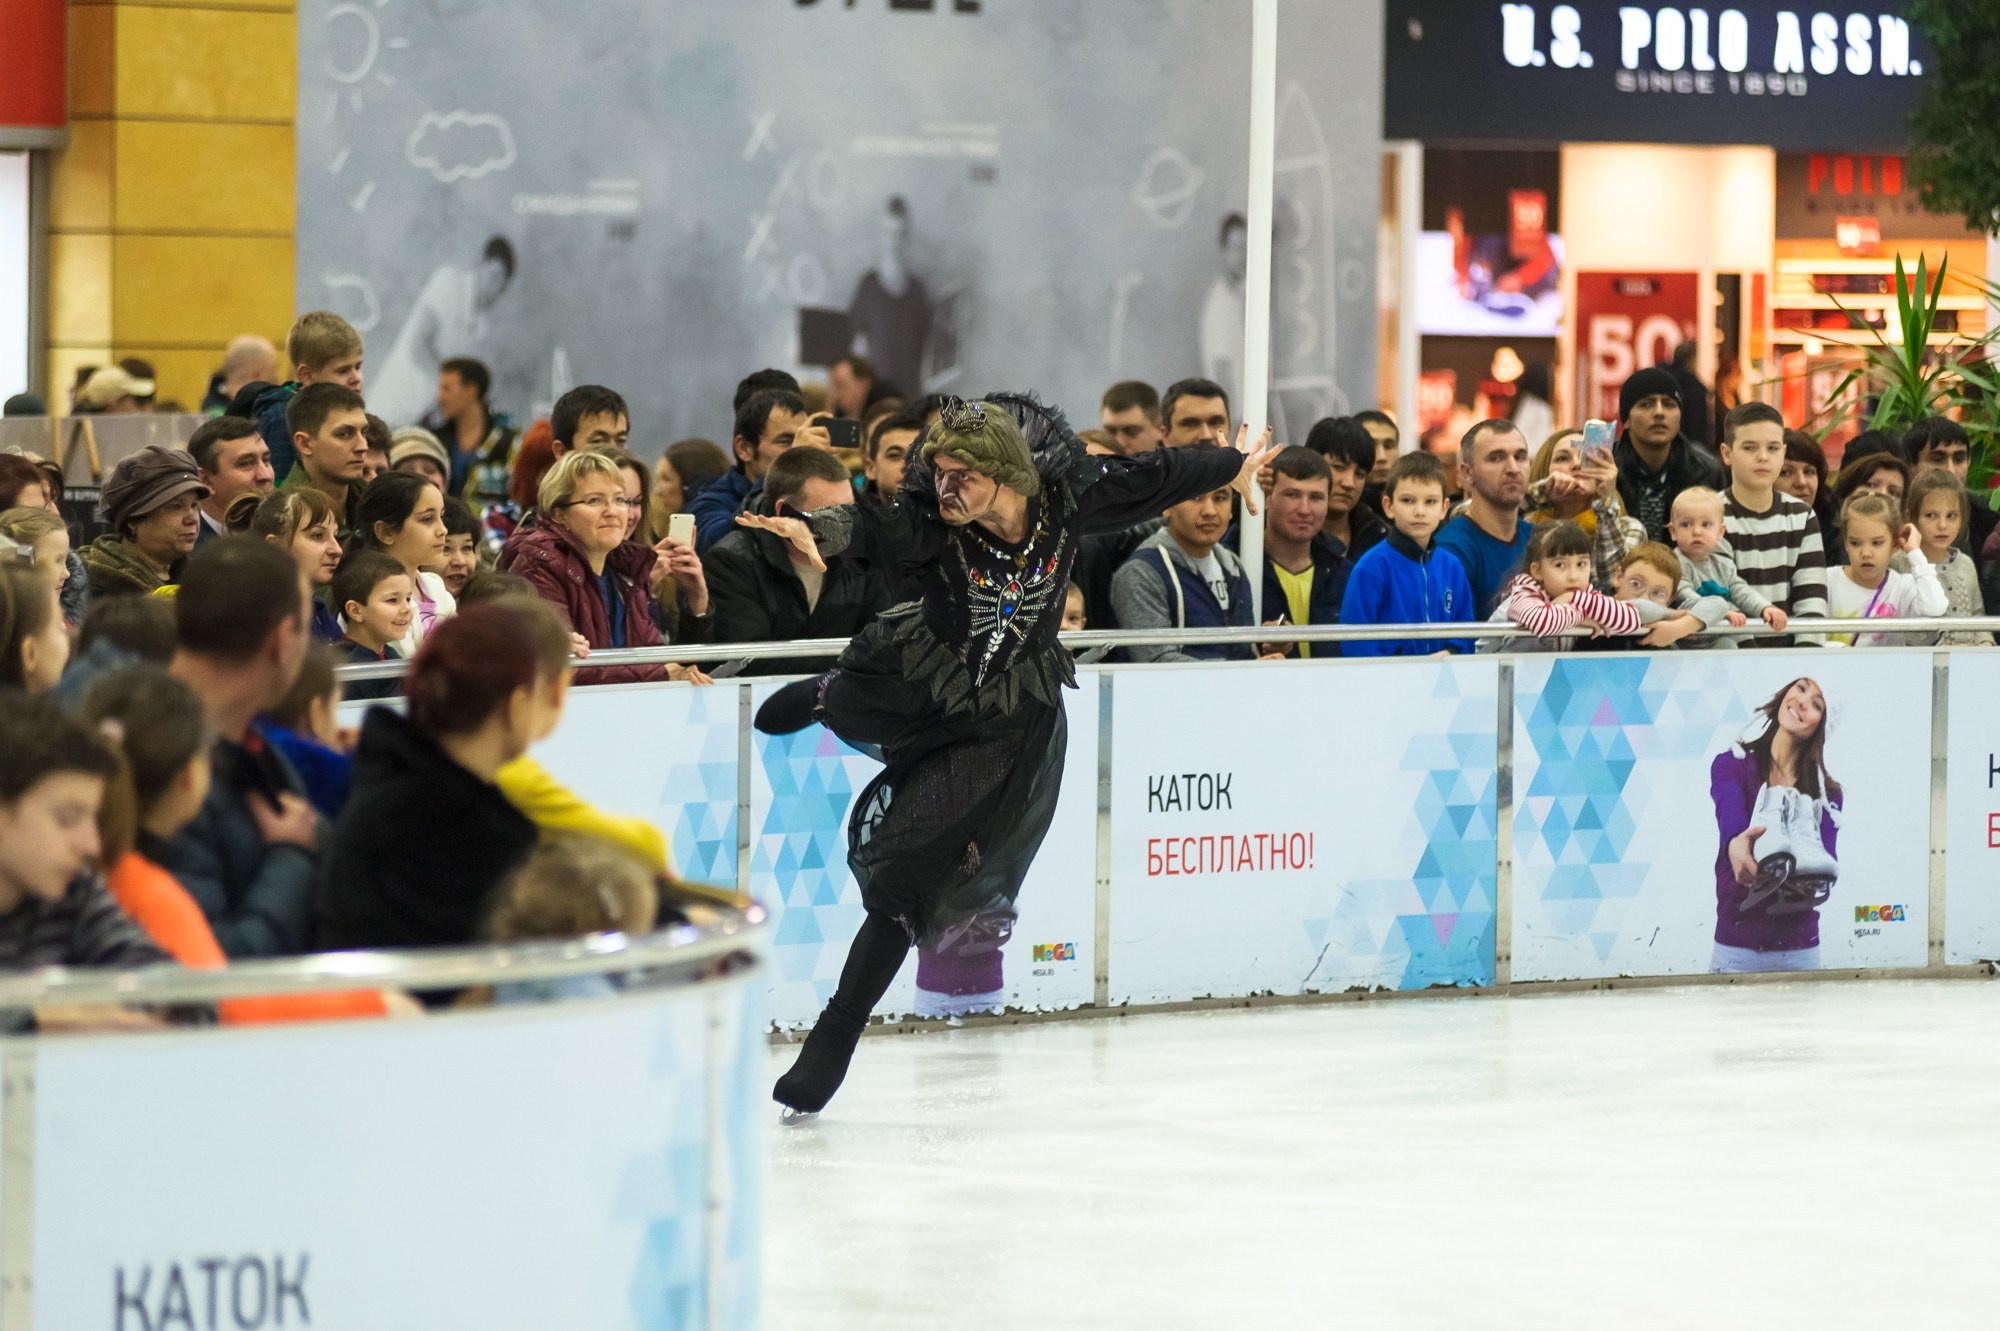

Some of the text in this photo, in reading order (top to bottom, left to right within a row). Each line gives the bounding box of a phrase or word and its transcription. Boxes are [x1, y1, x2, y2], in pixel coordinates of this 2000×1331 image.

[1501, 3, 1923, 76] U.S. POLO ASSN.
[1616, 69, 1808, 97] SINCE 1890
[1808, 154, 1903, 196] POLO
[1148, 773, 1232, 813] КАТОК
[1147, 832, 1314, 876] БЕСПЛАТНО!
[114, 1252, 312, 1331] КАТОК
